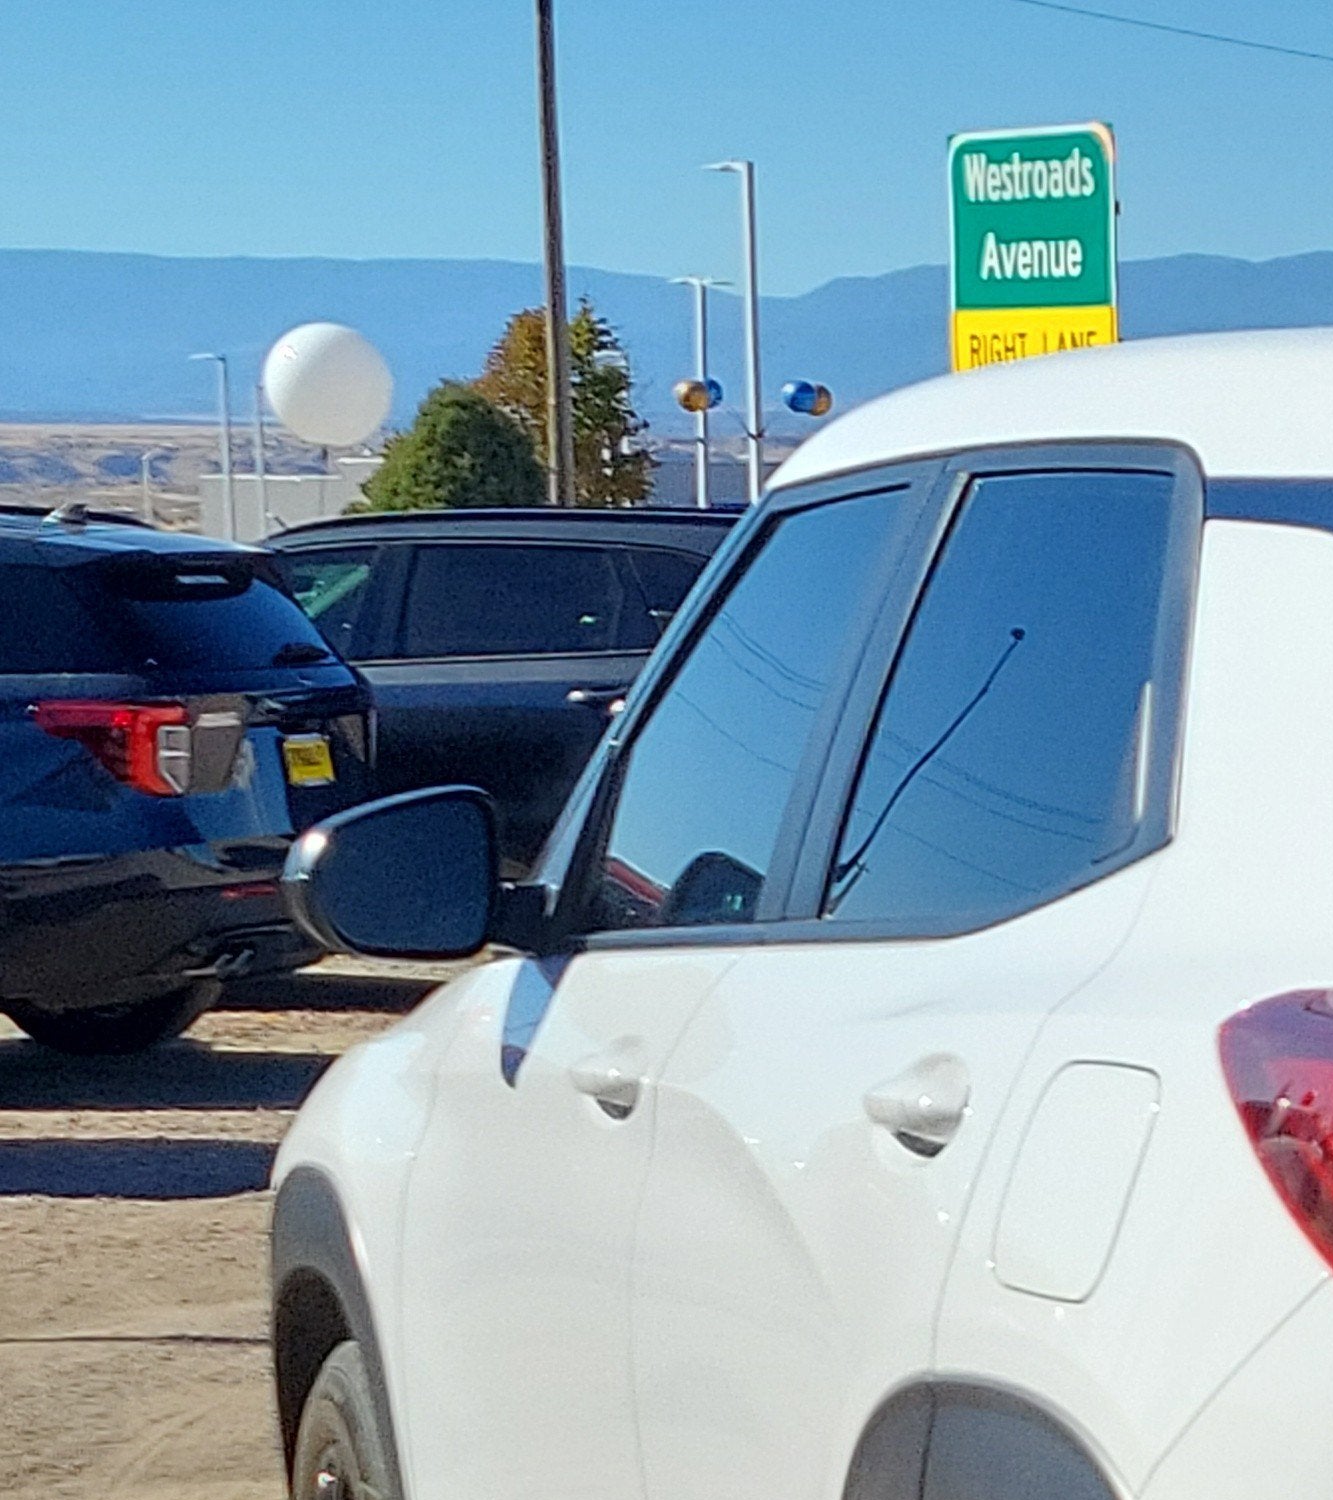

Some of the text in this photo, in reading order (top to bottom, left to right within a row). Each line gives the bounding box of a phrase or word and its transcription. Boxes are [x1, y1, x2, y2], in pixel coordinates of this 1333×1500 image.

[964, 148, 1095, 202] Westroads
[979, 231, 1082, 280] Avenue
[969, 333, 1027, 368] RIGHT
